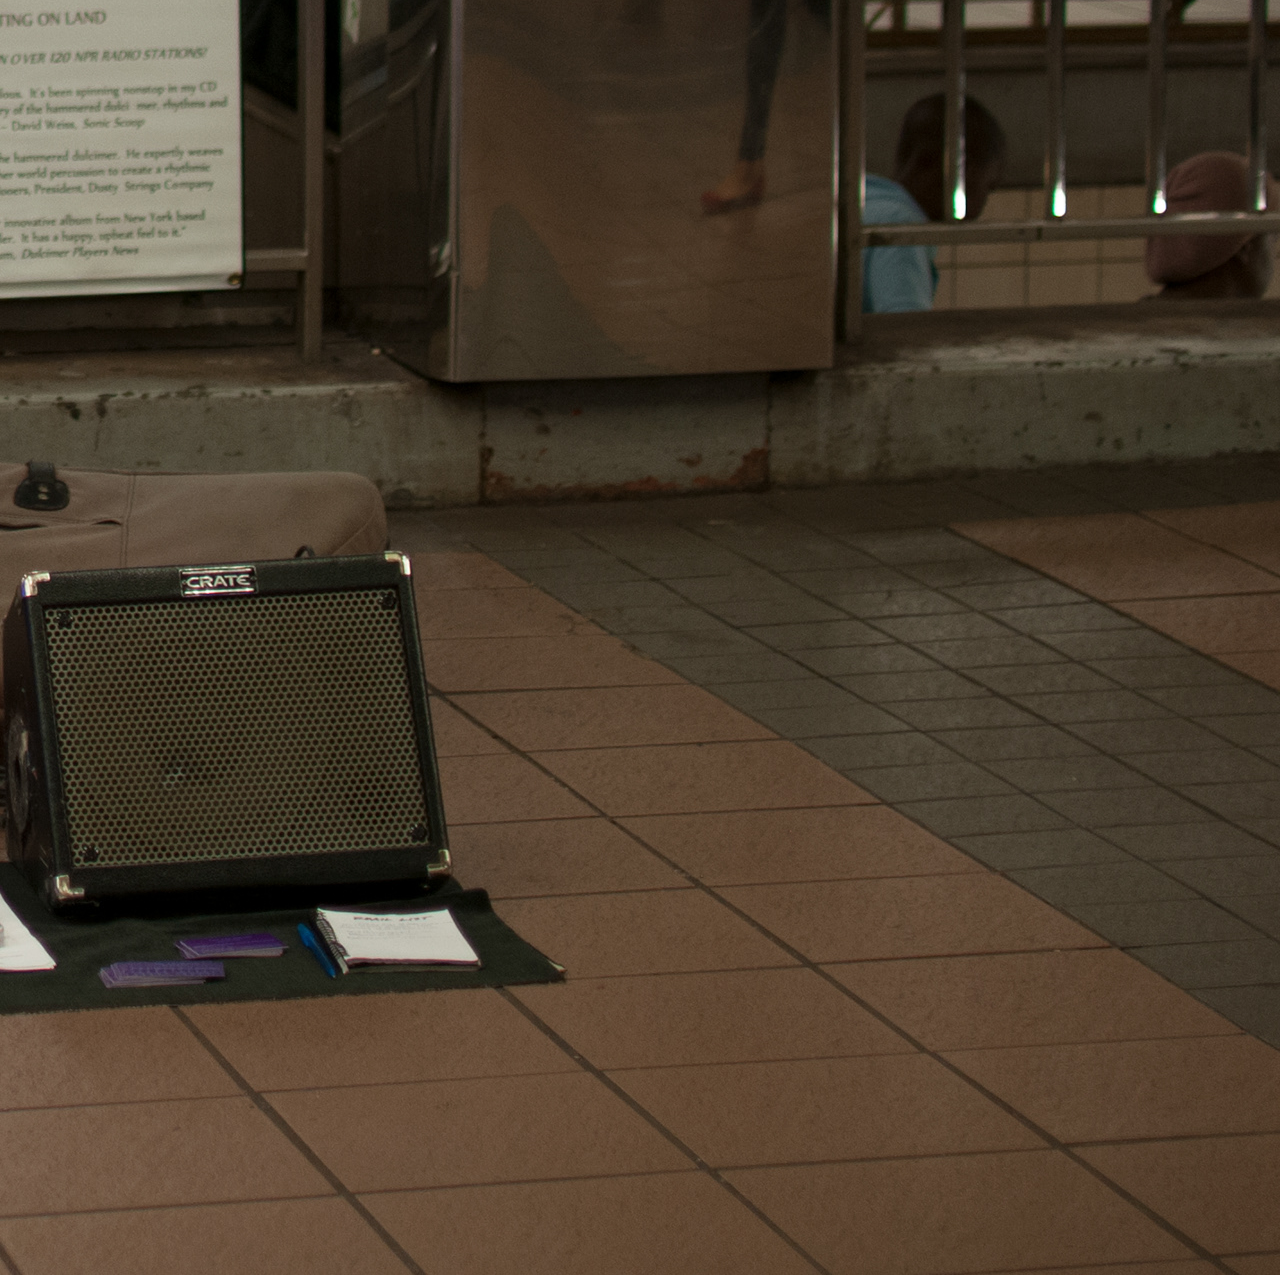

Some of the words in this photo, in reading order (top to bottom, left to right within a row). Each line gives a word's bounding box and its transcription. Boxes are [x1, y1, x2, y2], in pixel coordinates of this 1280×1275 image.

[38, 13, 60, 27] ON
[65, 10, 107, 26] LAND
[50, 52, 71, 63] 120
[74, 50, 98, 62] NPR
[102, 50, 141, 61] RADIO
[199, 80, 217, 93] CD
[186, 574, 251, 589] CRATE
